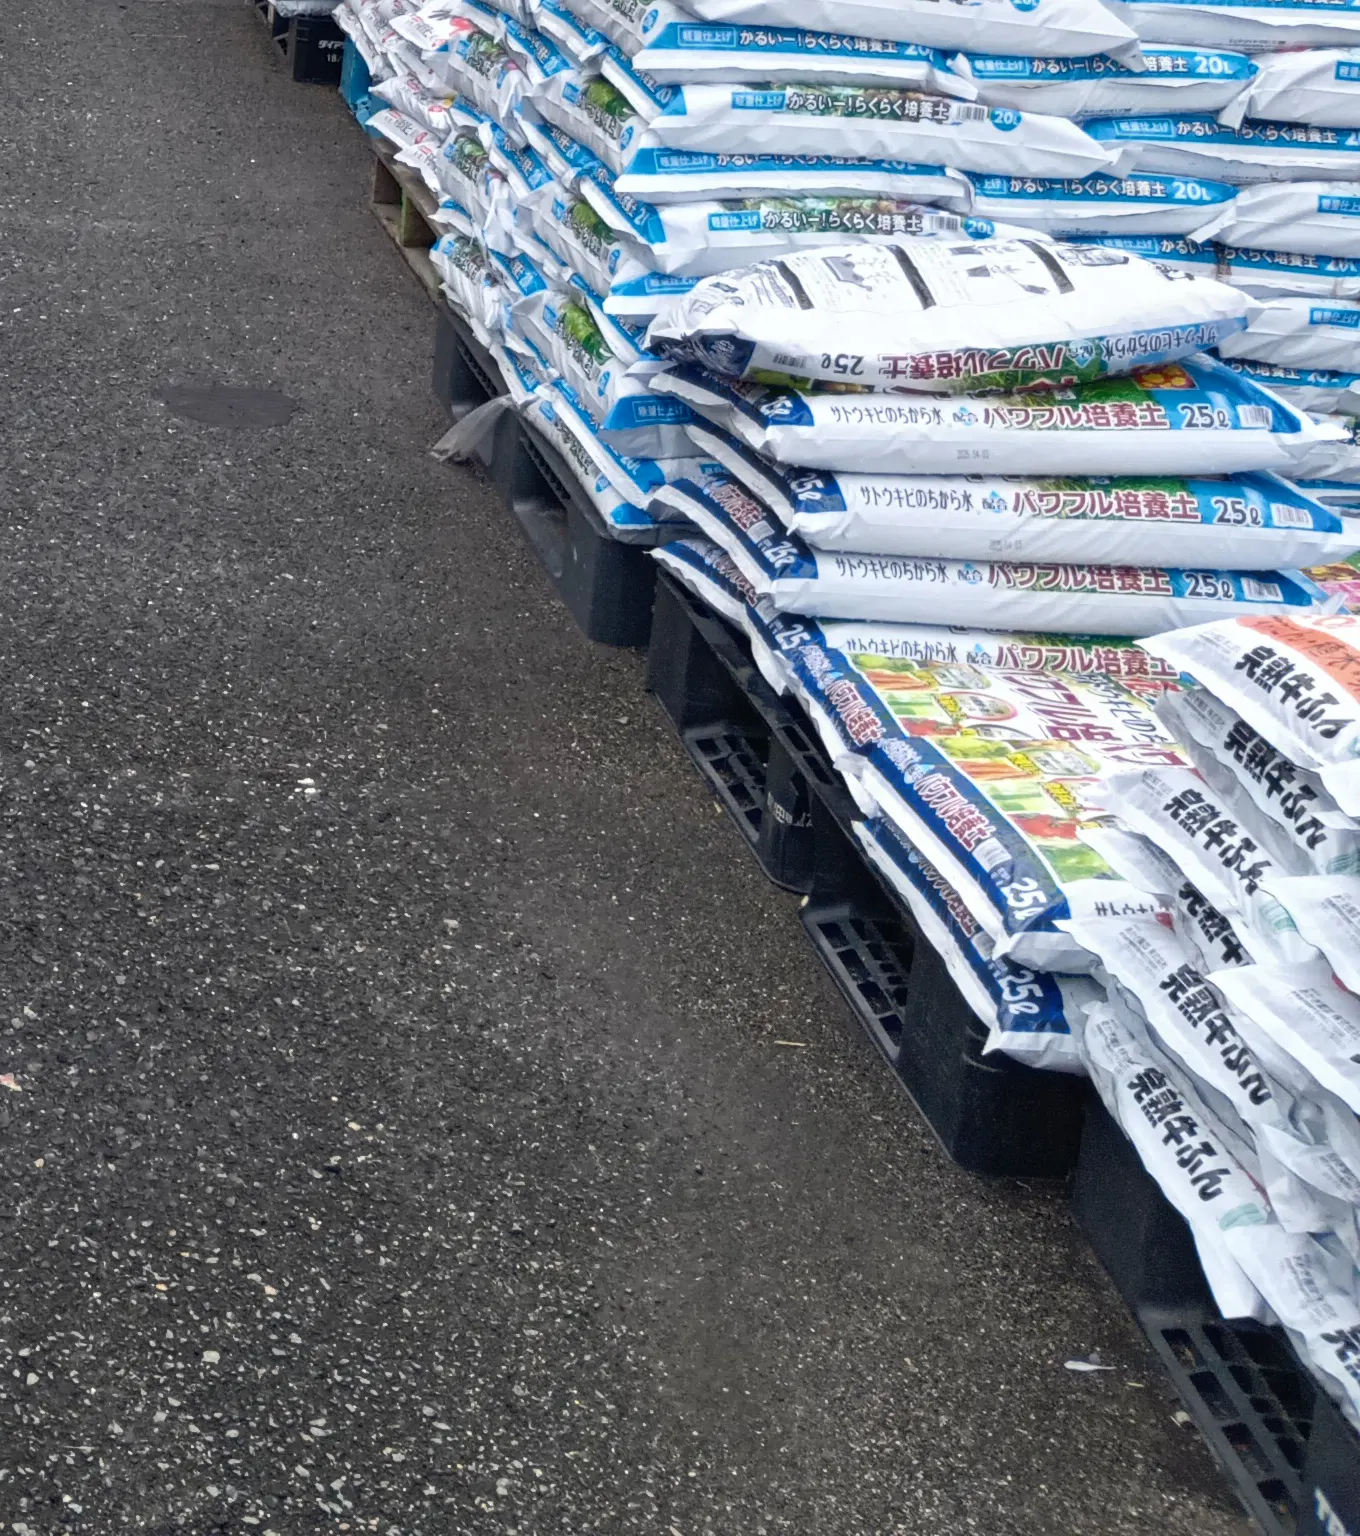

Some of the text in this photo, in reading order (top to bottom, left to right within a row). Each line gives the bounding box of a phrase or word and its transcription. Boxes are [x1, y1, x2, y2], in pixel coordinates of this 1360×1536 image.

[1195, 56, 1234, 74] 20L
[1173, 181, 1212, 200] 20L
[879, 345, 1064, 381] パワフル培養土
[830, 405, 944, 426] サトウキビのちから水
[983, 403, 1169, 430] パワフル培養土
[860, 486, 974, 512] サトウキビのちから水
[1012, 490, 1201, 523] パワフル培養土
[836, 557, 950, 583] サトウキビのちから水
[986, 565, 1173, 596] パワフル培養土
[995, 644, 1181, 678] パワフル培養土
[1235, 645, 1356, 740] 完熟牛ふん
[1223, 719, 1328, 851] 完熟牛ふん
[1163, 788, 1274, 897] 完熟牛ふん
[1127, 1066, 1232, 1202] 完熟牛ふん
